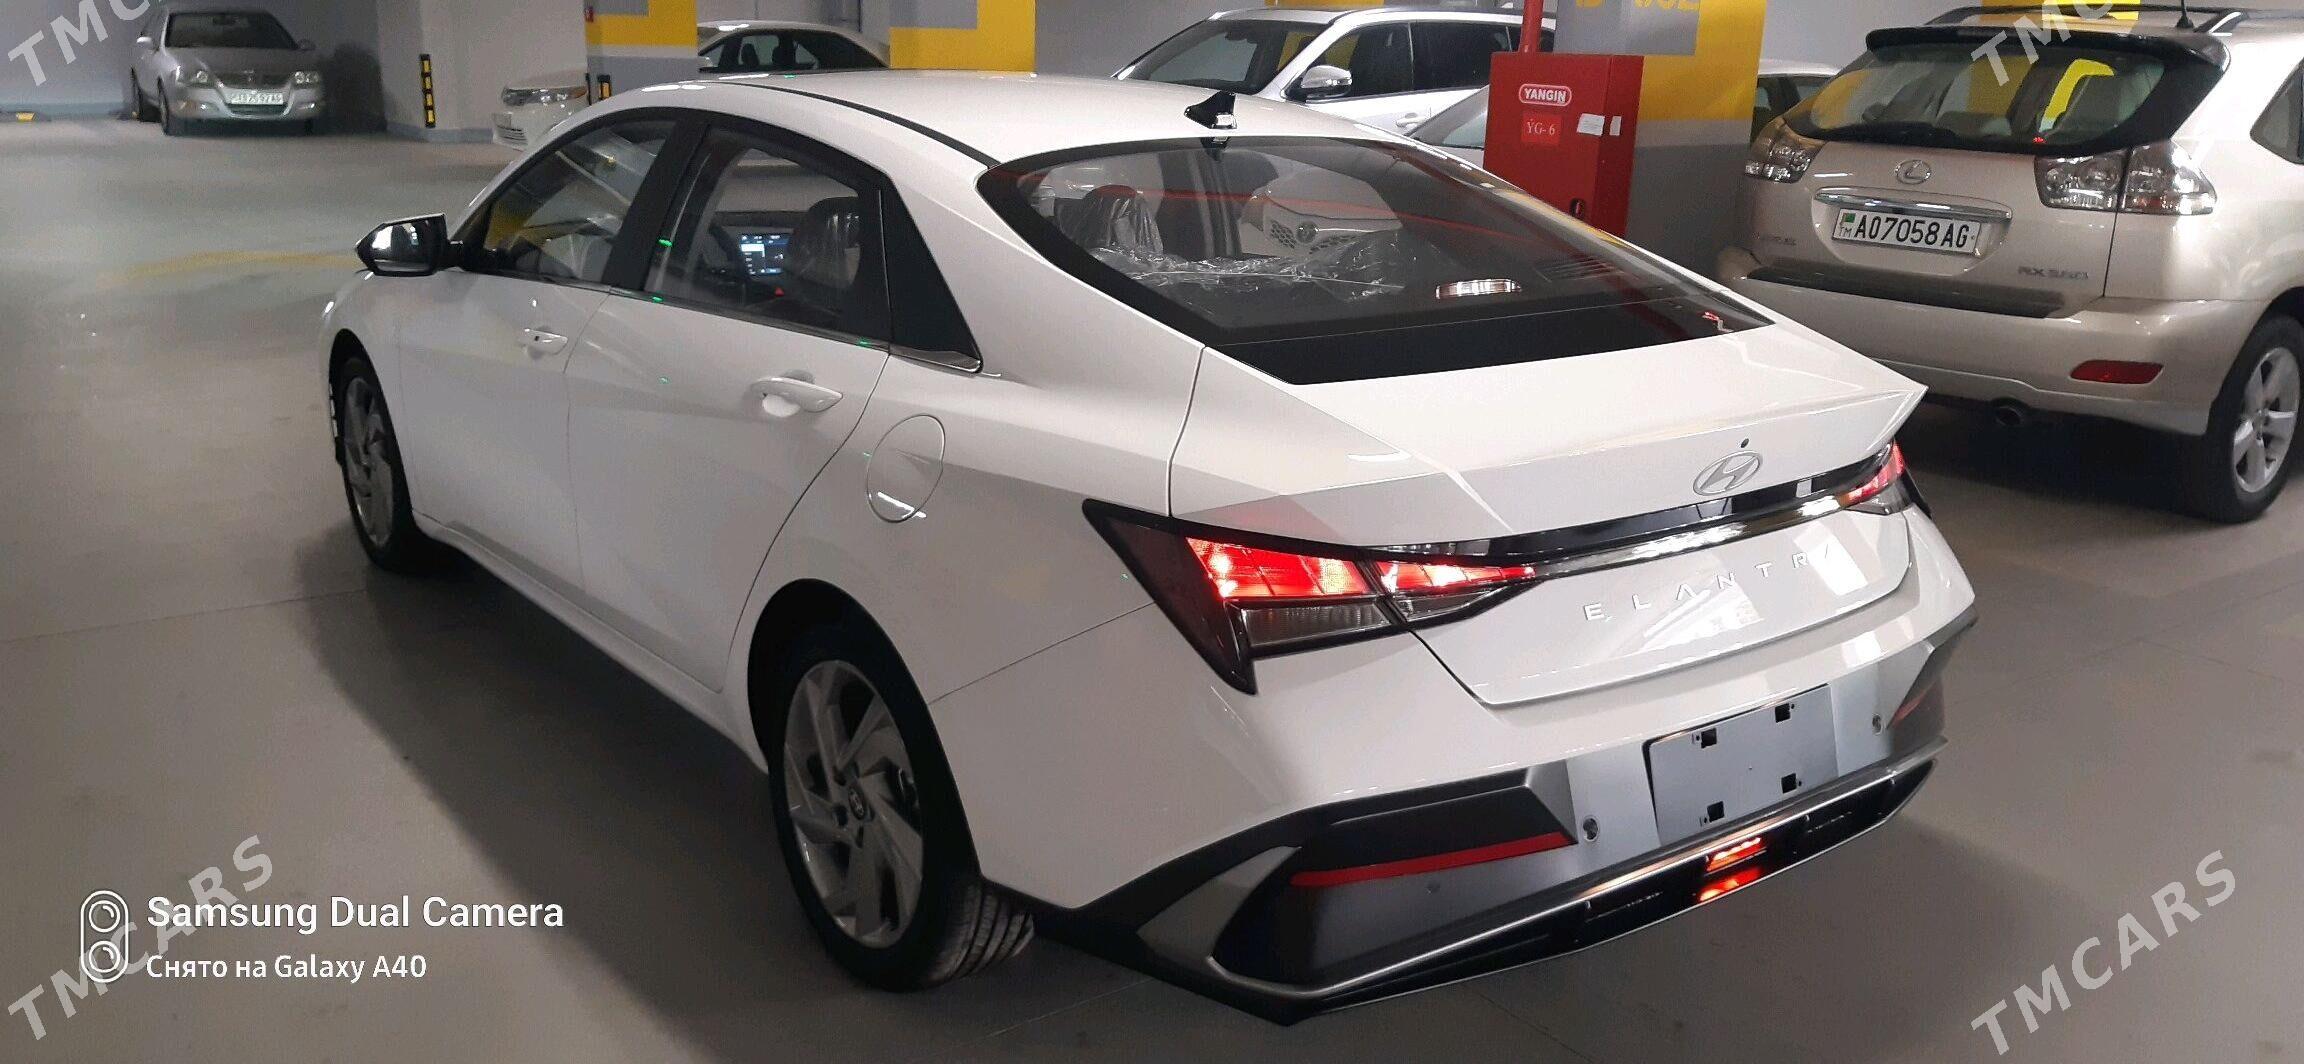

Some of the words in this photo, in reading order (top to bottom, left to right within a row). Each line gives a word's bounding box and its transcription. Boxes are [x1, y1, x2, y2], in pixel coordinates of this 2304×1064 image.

[1523, 87, 1567, 104] YANGIN
[1854, 214, 1970, 249] A07058AG
[1583, 543, 1829, 621] ELANTR
